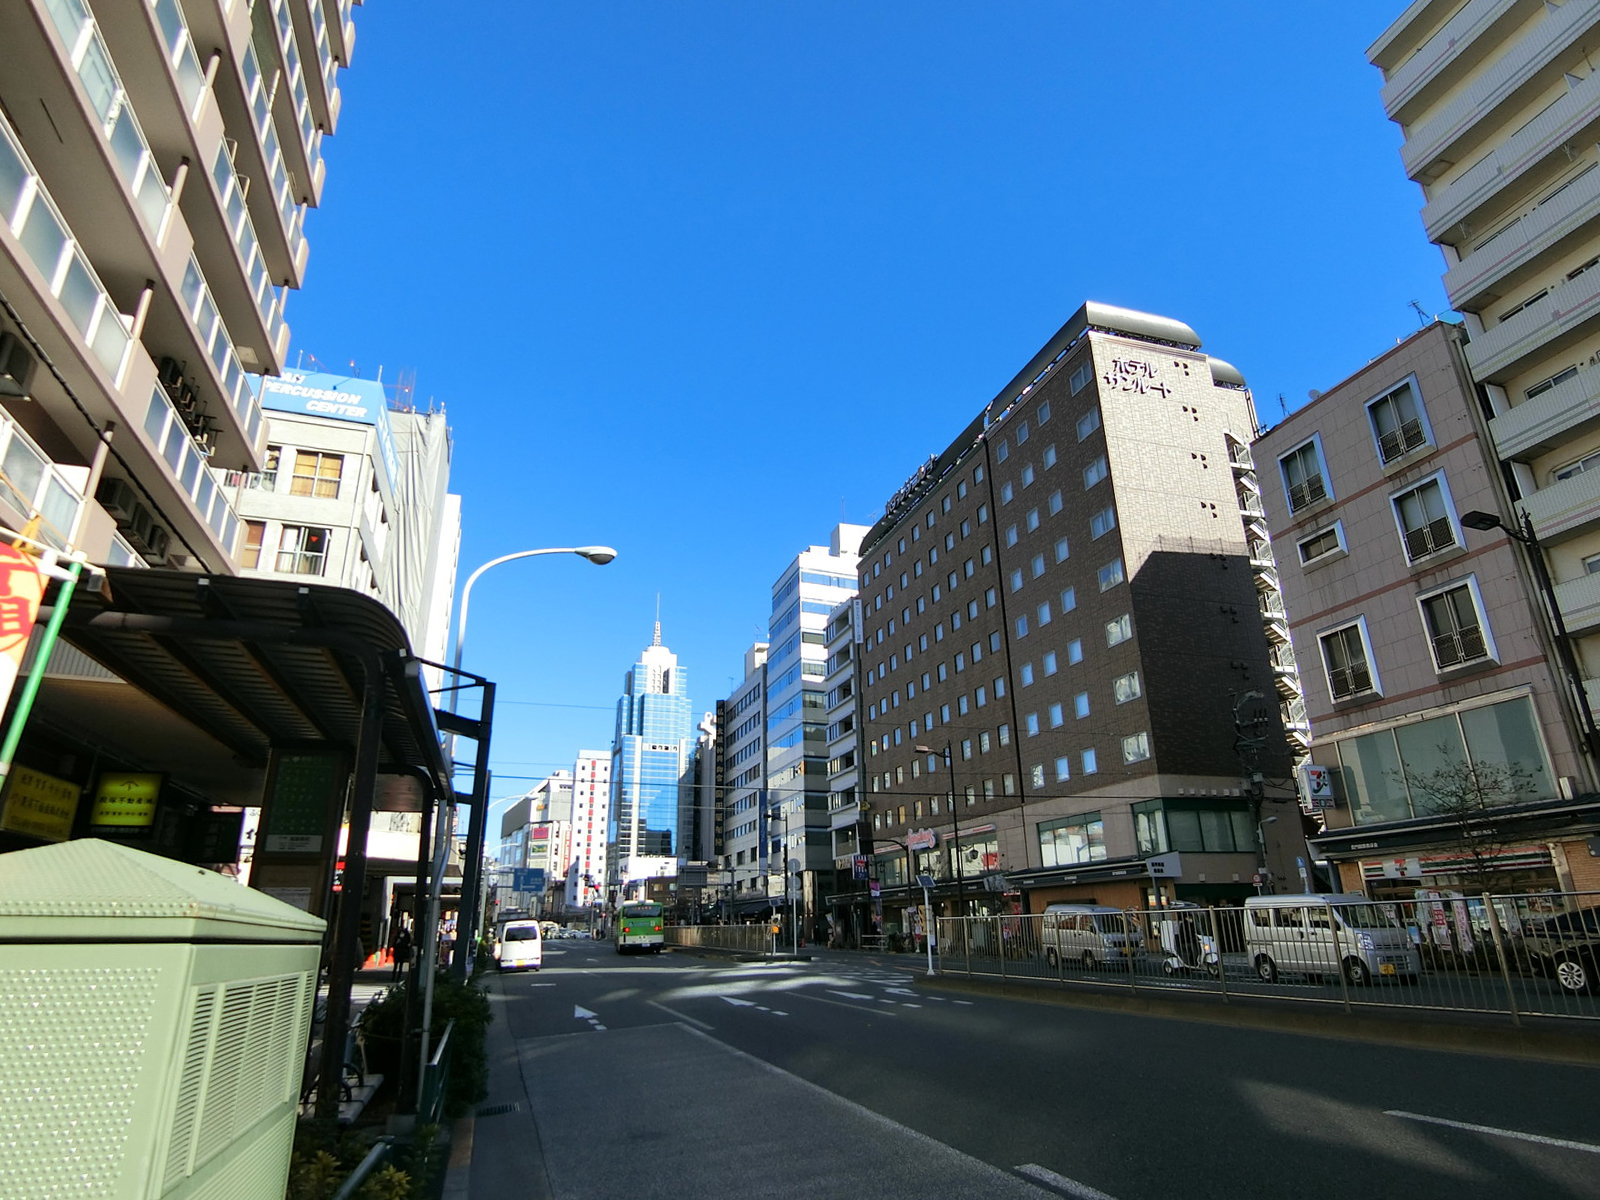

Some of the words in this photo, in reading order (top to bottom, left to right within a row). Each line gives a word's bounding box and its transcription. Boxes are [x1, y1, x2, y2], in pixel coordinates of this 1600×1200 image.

[1111, 357, 1159, 379] ホテル
[1103, 371, 1172, 399] サンルート
[306, 400, 368, 417] CENTER
